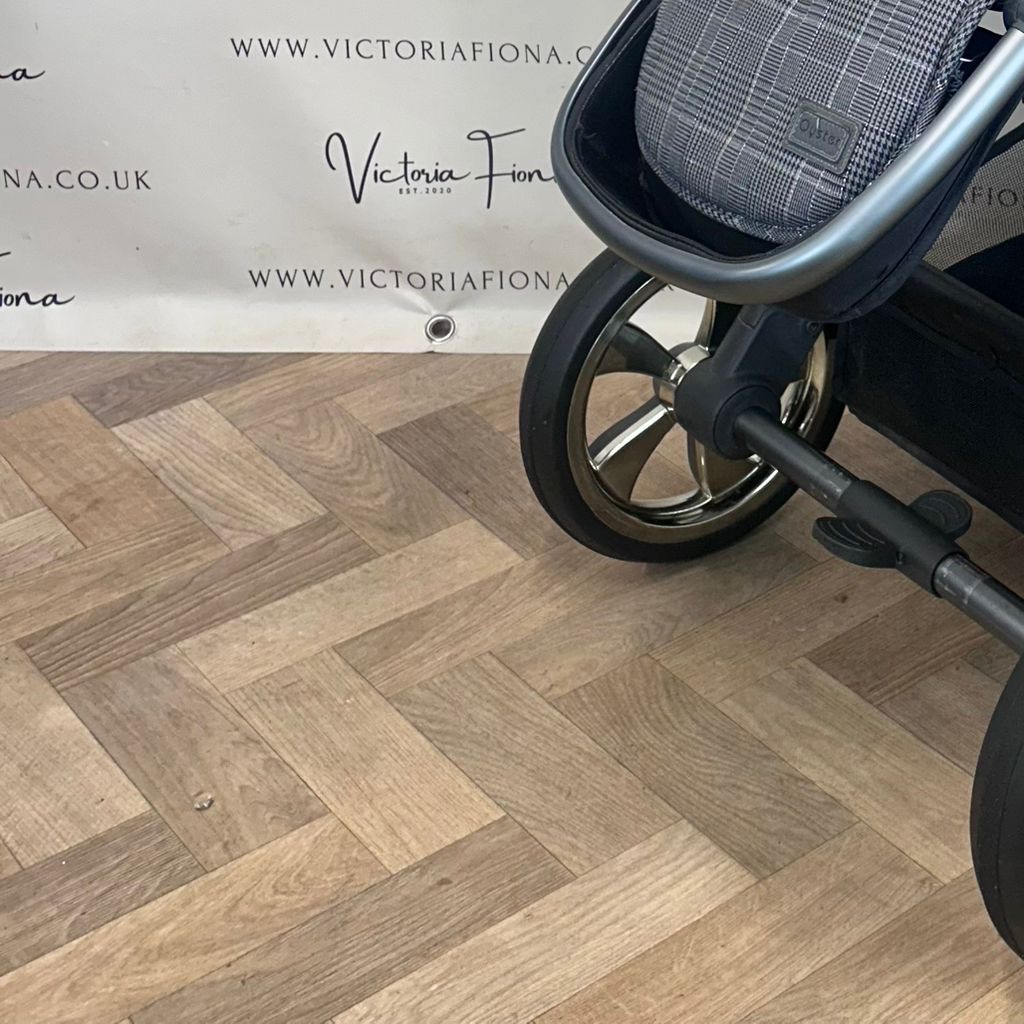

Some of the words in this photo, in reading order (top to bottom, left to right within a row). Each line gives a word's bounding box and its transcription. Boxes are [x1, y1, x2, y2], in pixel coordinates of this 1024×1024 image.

[800, 118, 841, 145] Oyster
[325, 132, 471, 204] Victoria
[467, 128, 557, 209] Fion
[399, 187, 452, 195] EST.2020
